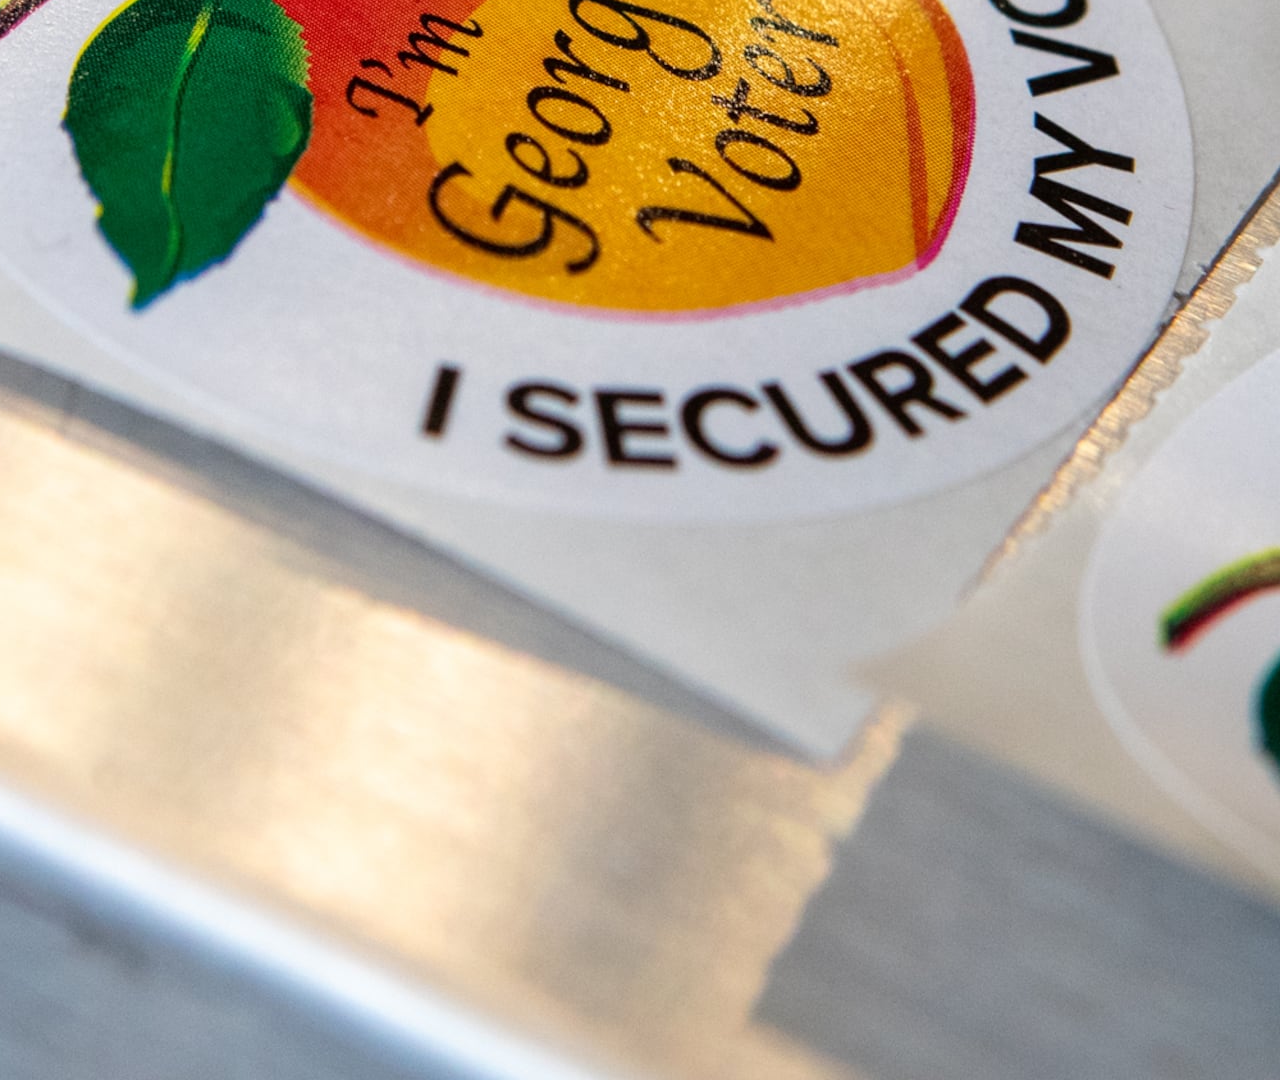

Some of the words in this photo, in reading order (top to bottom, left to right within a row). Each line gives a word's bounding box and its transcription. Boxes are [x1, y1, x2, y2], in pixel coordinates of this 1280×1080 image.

[422, 364, 462, 438] I
[504, 275, 1073, 470] SECURED
[1014, 113, 1136, 280] MY
